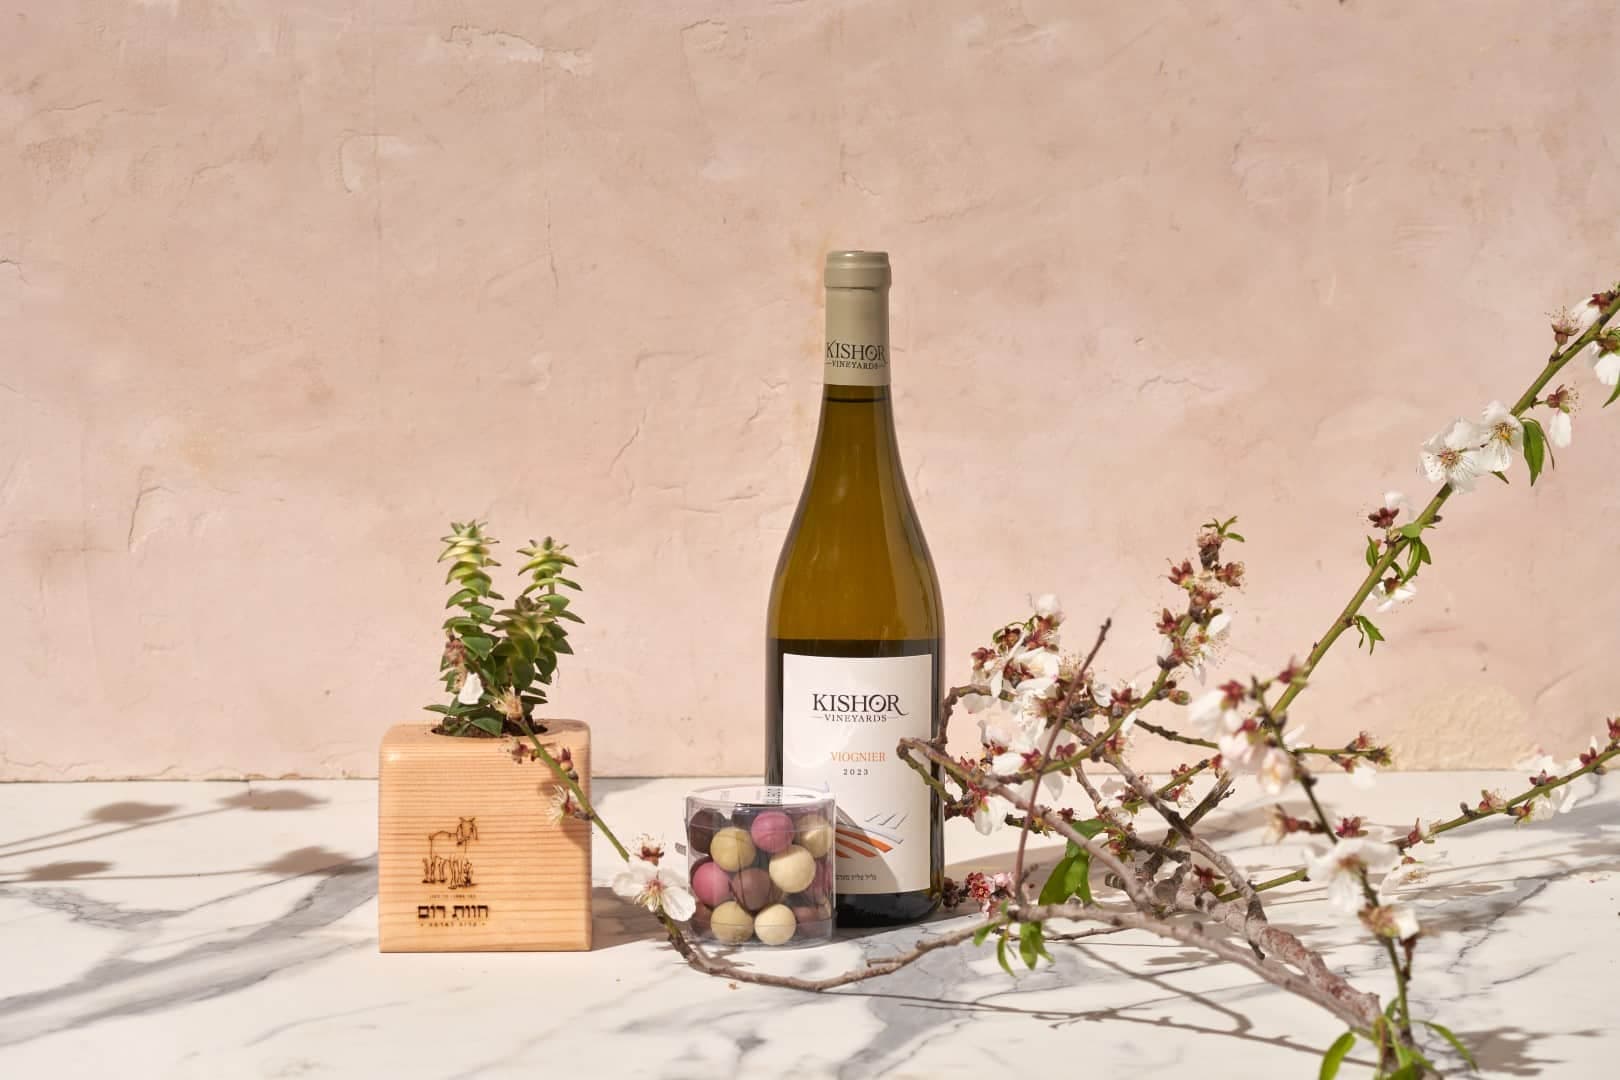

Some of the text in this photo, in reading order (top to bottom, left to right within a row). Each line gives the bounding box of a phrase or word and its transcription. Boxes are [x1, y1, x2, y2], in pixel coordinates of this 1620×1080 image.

[826, 340, 888, 365] KISHOR
[831, 360, 880, 370] VINEYARDS
[813, 693, 909, 716] KISHOR
[824, 713, 887, 723] VINEYARDS
[831, 751, 886, 762] VIOGNIER
[843, 768, 869, 776] 2023
[418, 905, 489, 920] חוות רום
